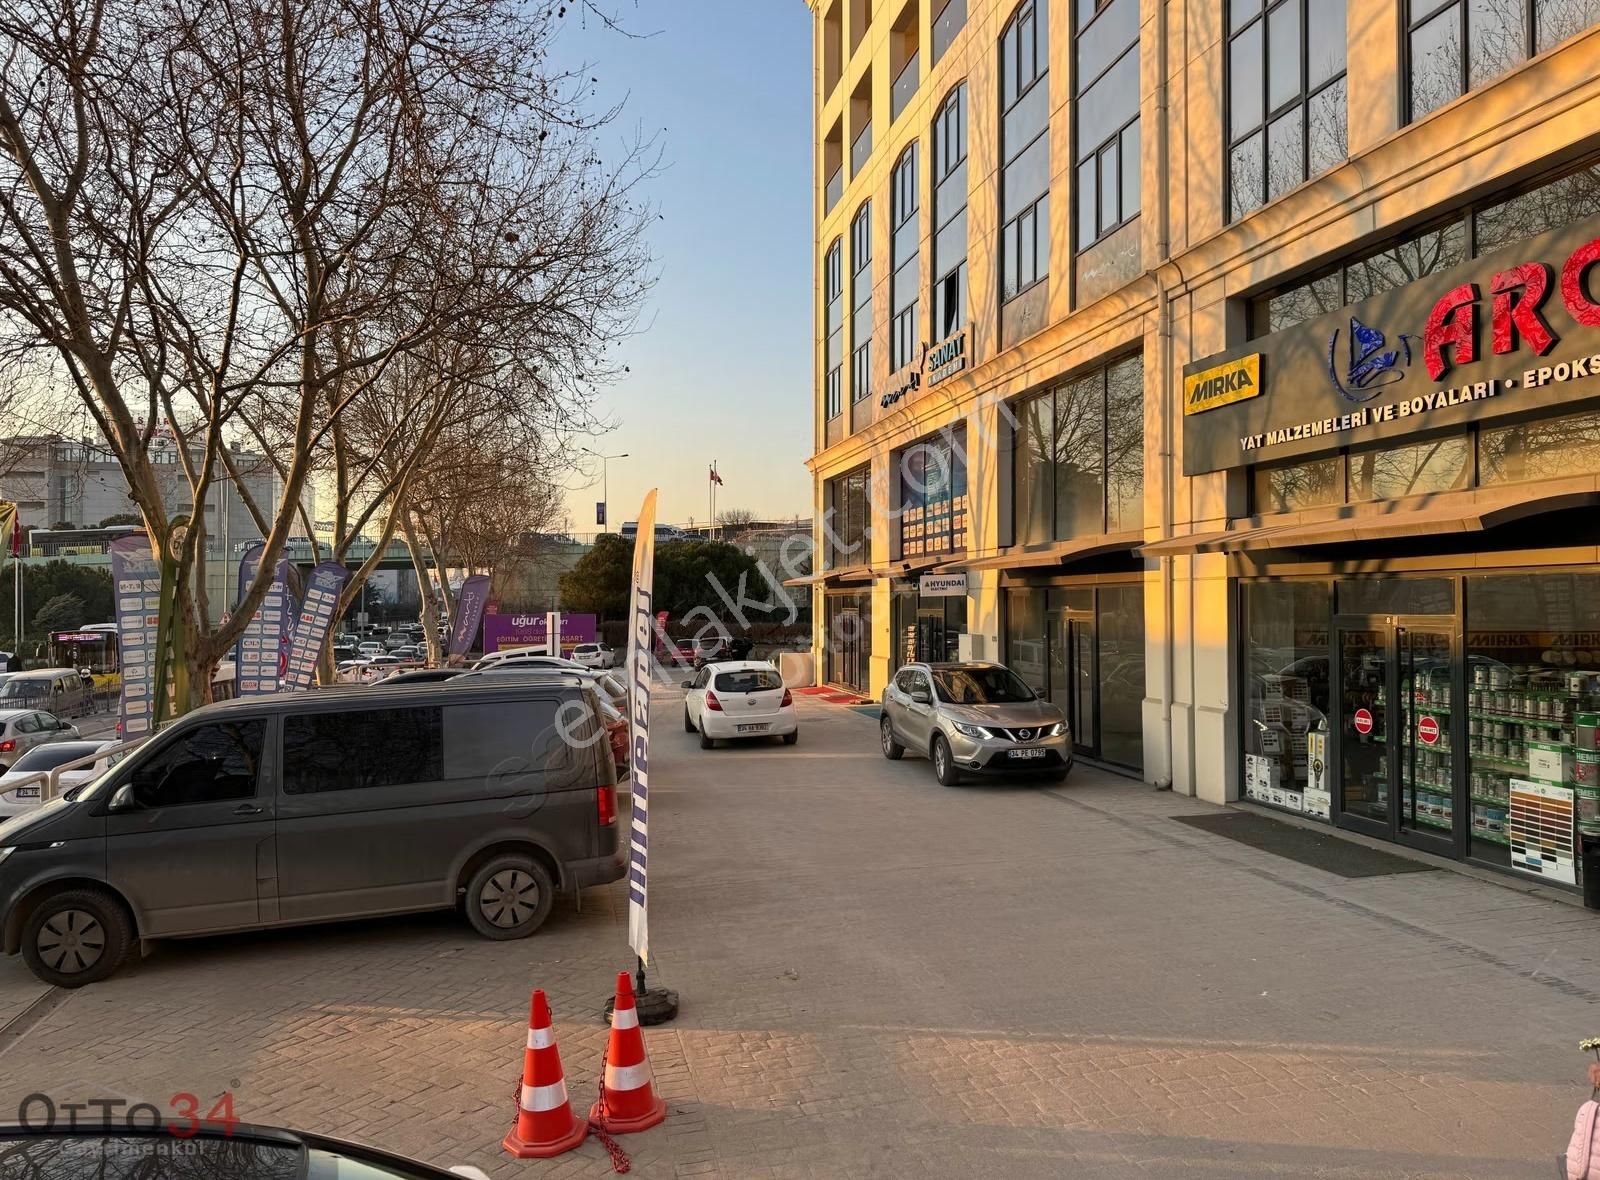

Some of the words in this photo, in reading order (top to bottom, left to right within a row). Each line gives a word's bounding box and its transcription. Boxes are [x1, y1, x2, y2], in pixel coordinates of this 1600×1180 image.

[929, 334, 966, 372] SANAT
[1189, 368, 1253, 404] MIRKA
[1240, 434, 1263, 450] YAT
[1267, 408, 1368, 446] MALZEMELERİ
[1373, 405, 1394, 422] VE
[1399, 379, 1495, 418] BOYALARI
[512, 614, 540, 628] uğur
[1469, 633, 1530, 646] MIRKA
